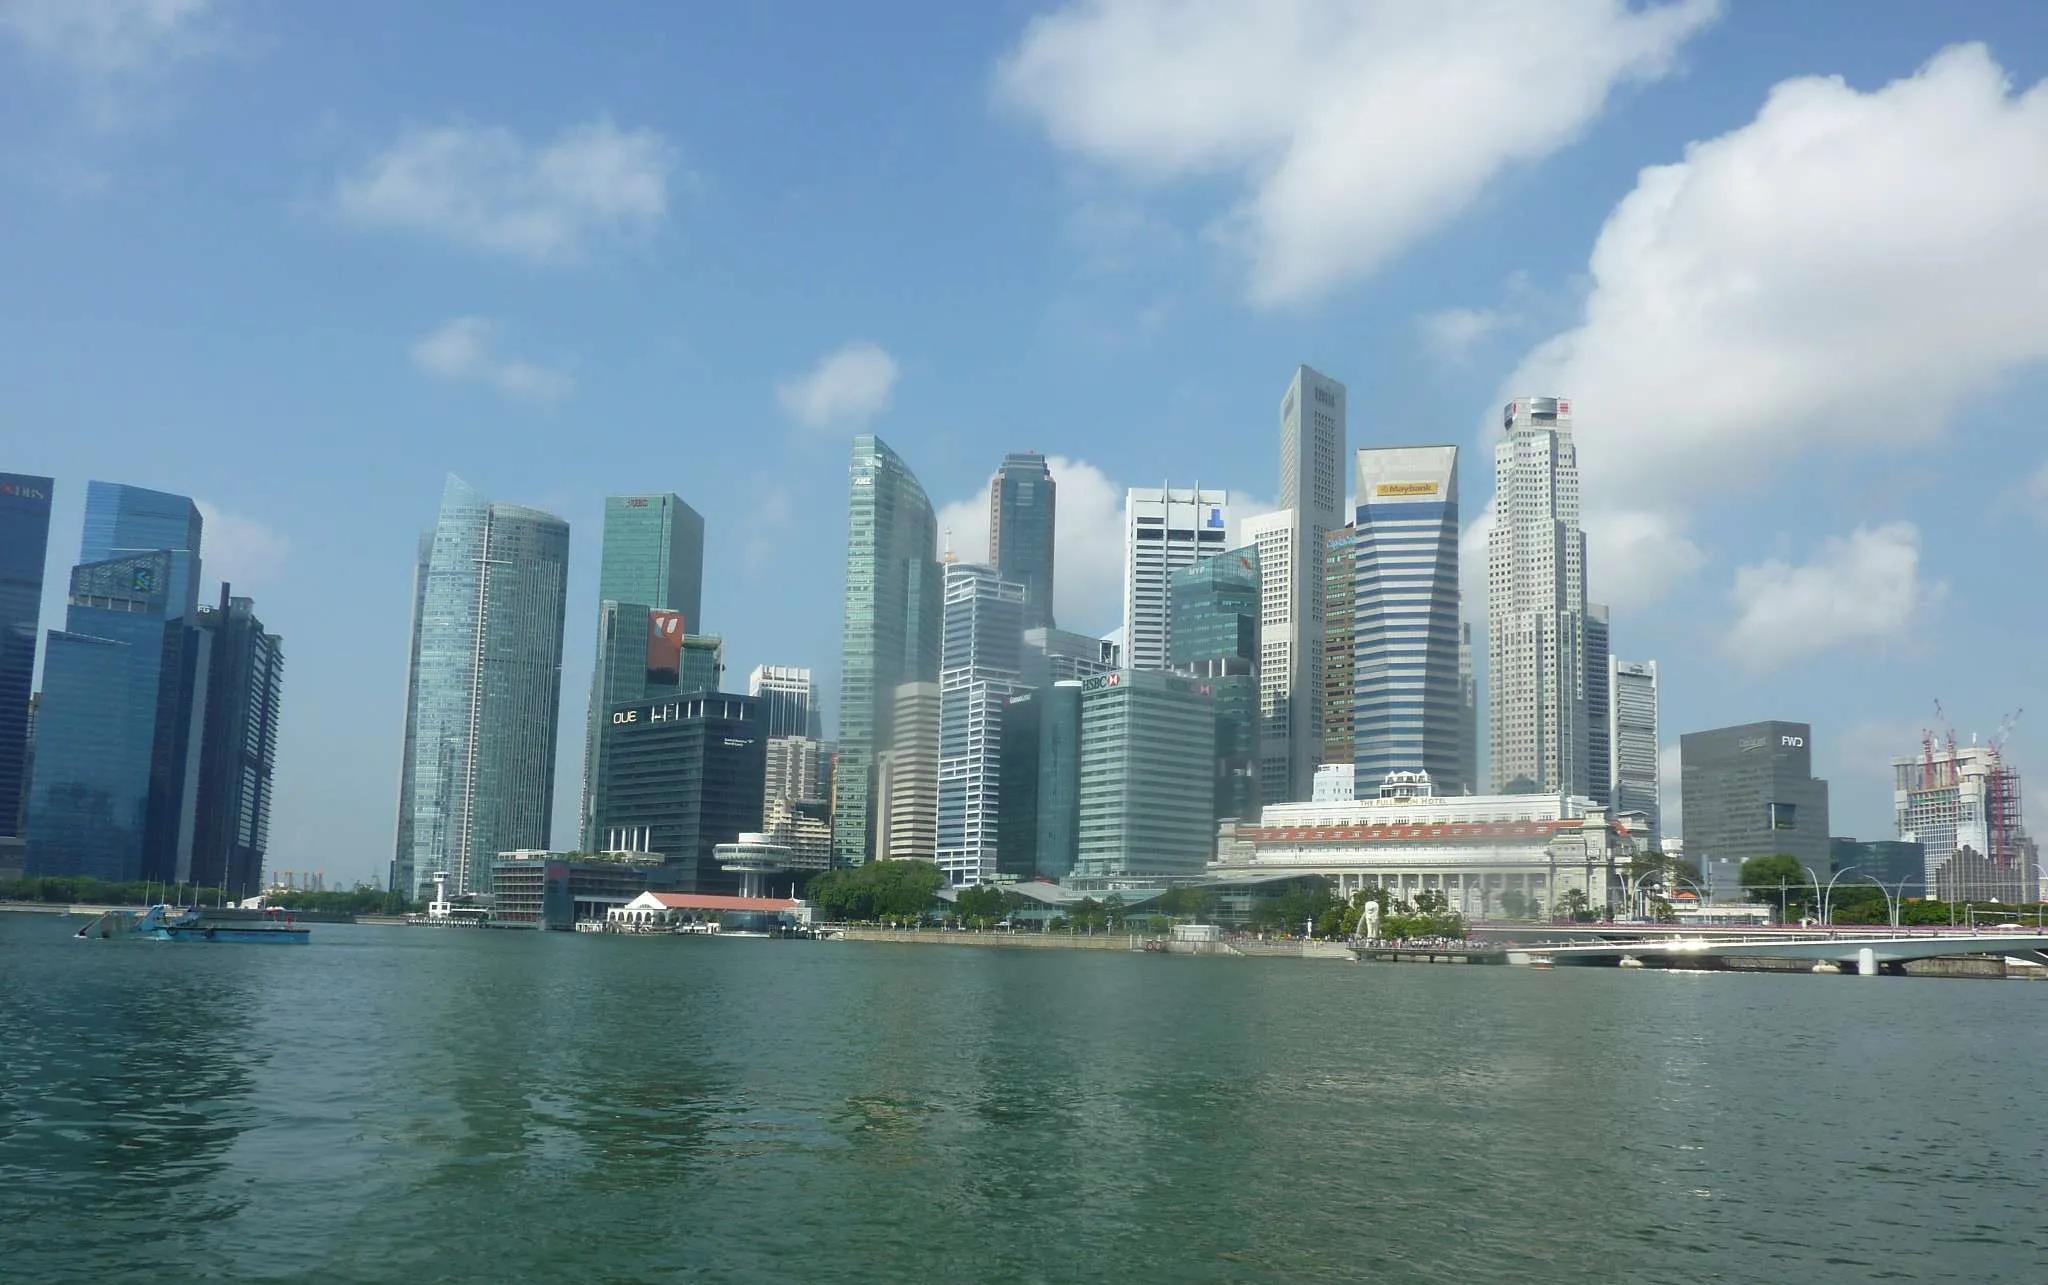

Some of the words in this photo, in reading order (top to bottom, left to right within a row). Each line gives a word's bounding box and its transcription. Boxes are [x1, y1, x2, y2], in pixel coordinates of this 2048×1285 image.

[1389, 483, 1432, 495] Maybank
[1082, 675, 1107, 692] HSBC
[613, 710, 637, 724] OUE
[1782, 735, 1803, 747] FWD
[1421, 796, 1447, 805] HOTEL
